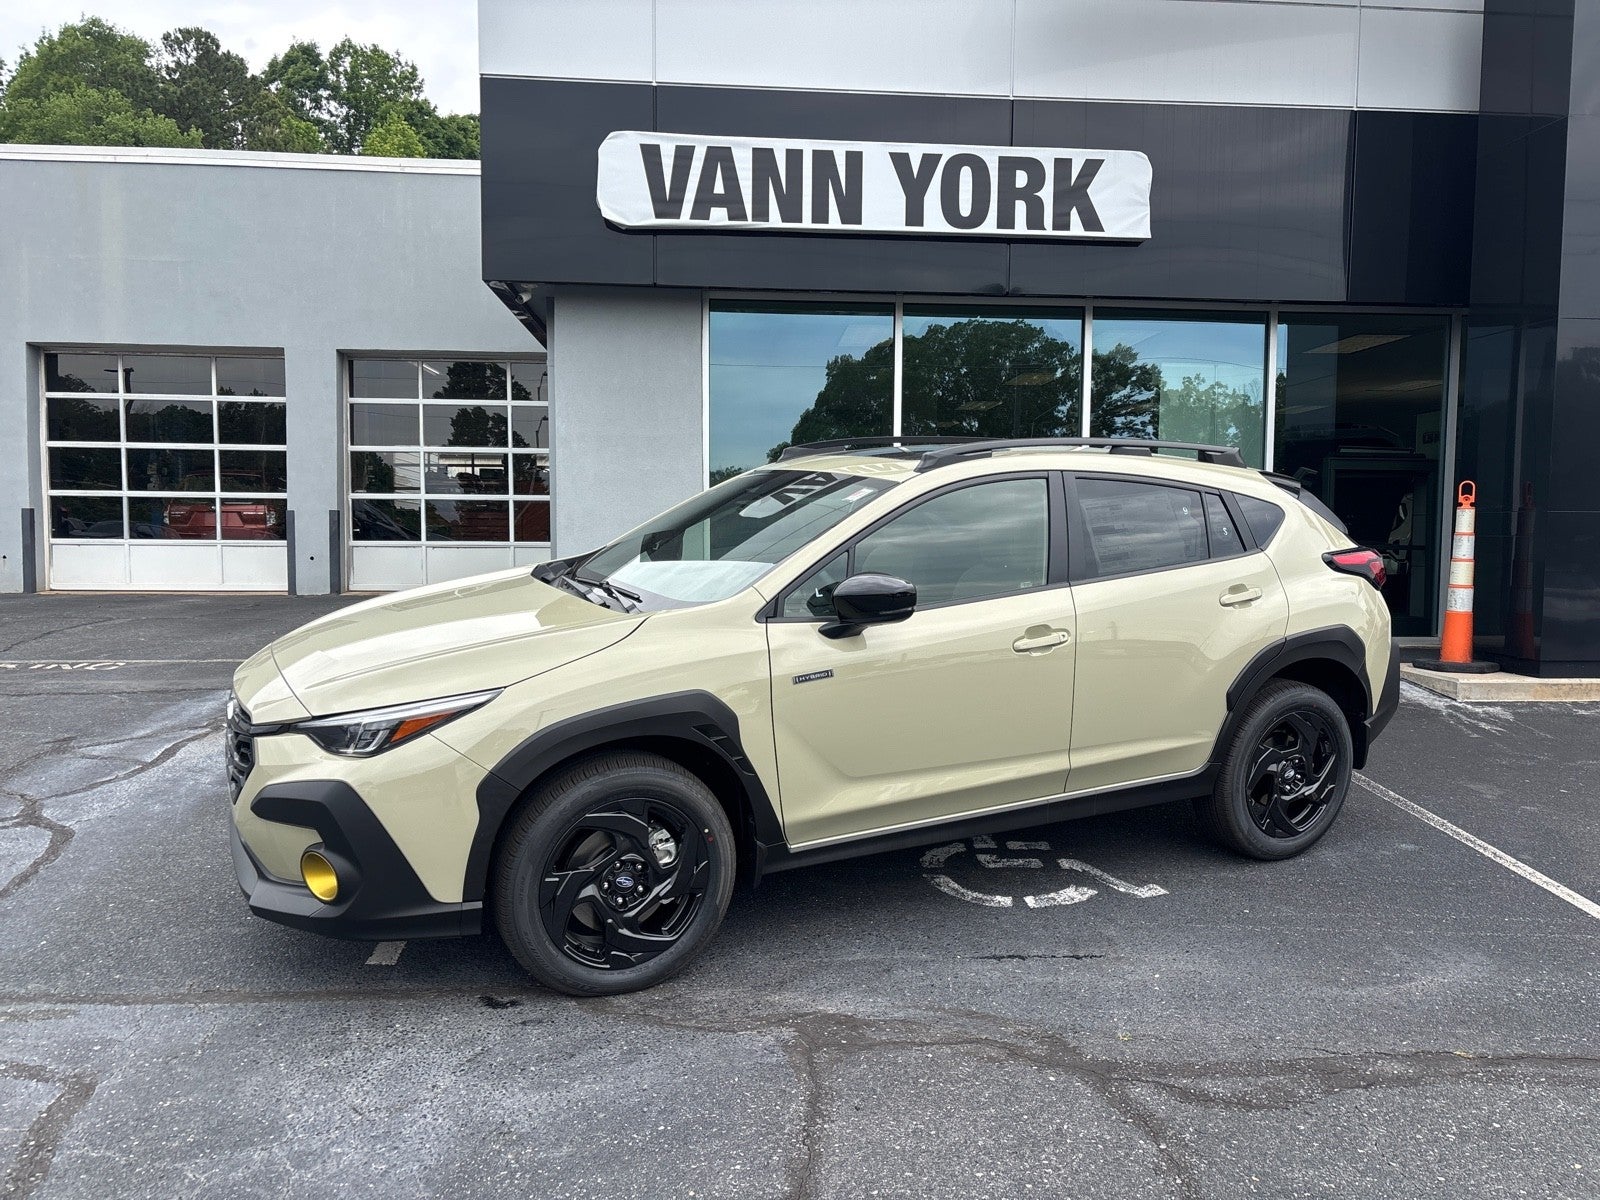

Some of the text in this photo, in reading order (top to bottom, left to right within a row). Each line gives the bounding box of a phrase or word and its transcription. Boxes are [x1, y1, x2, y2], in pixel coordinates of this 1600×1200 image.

[640, 143, 1105, 233] VANN YORK
[798, 671, 830, 682] HYBRID
